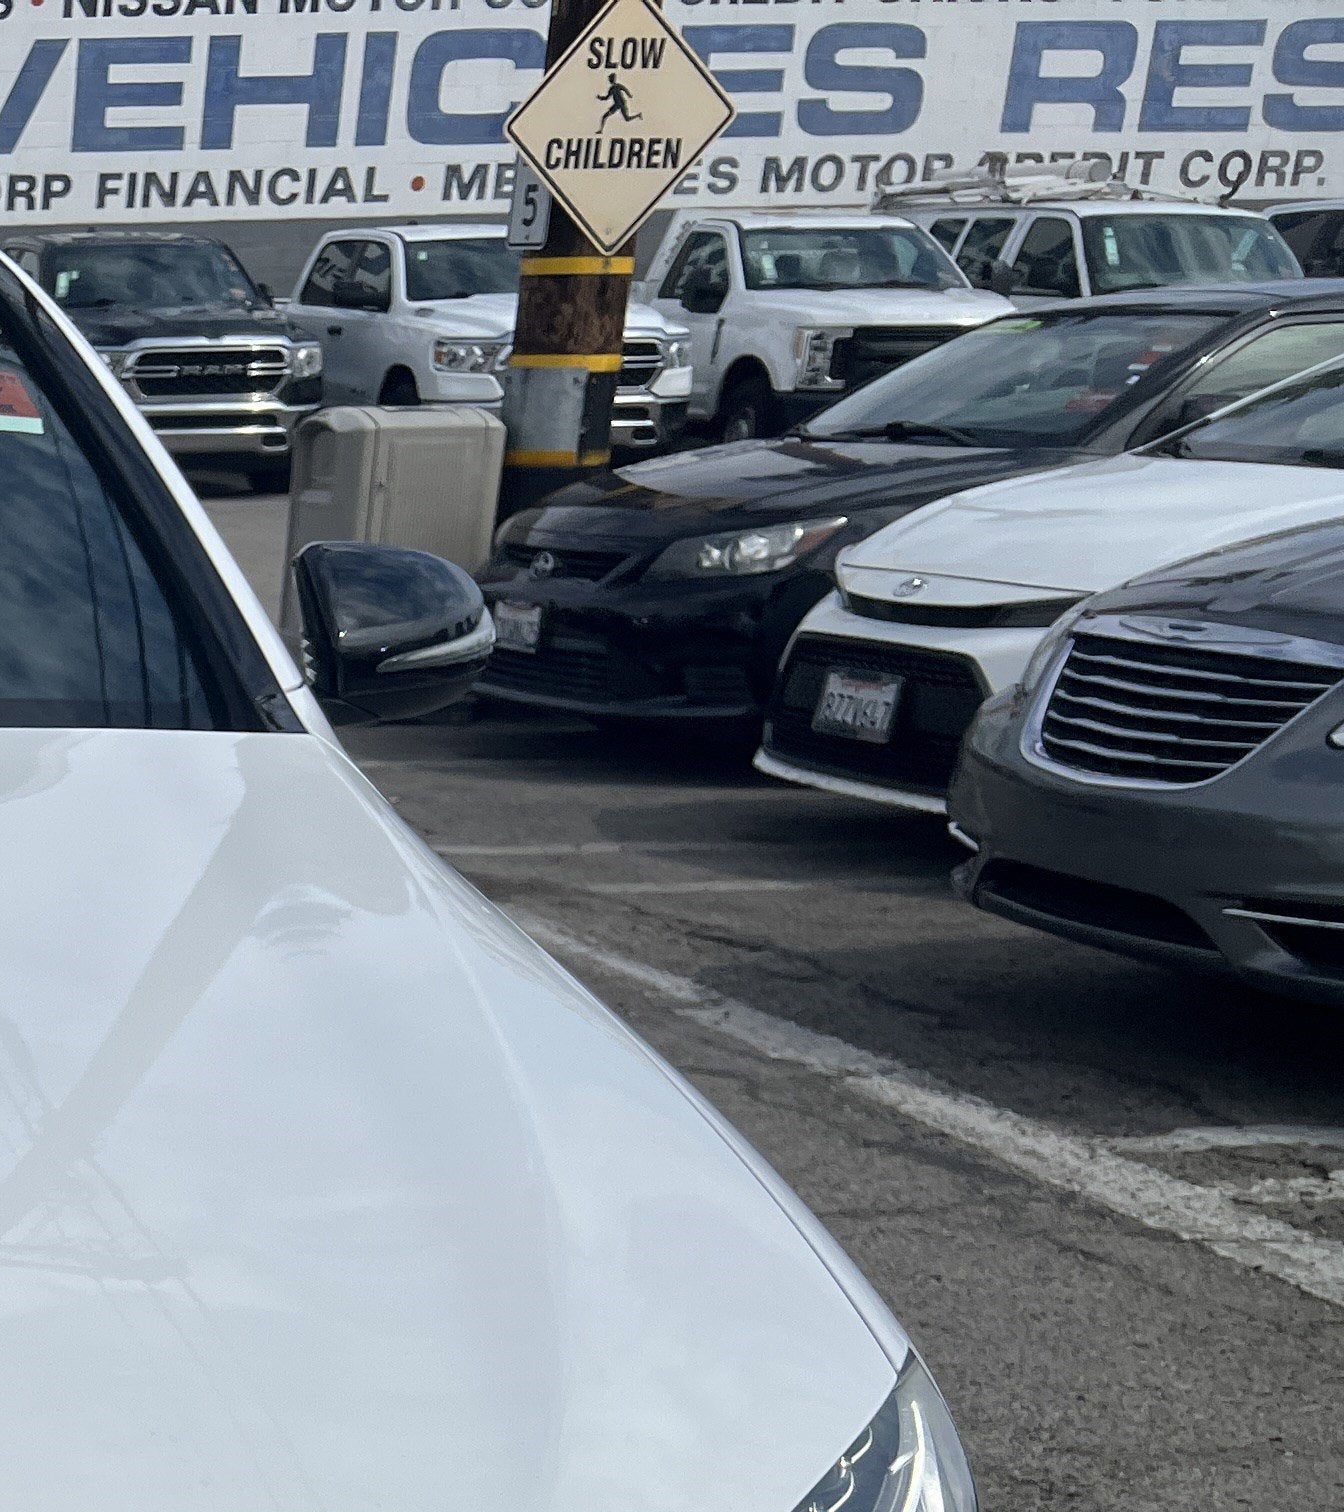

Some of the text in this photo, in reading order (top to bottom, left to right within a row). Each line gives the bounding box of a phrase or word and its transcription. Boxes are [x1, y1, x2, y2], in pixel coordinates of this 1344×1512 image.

[587, 37, 667, 70] SLOW
[544, 137, 683, 170] CHILDREN
[96, 166, 391, 210] FINANCIAL
[1179, 150, 1326, 189] CORP.
